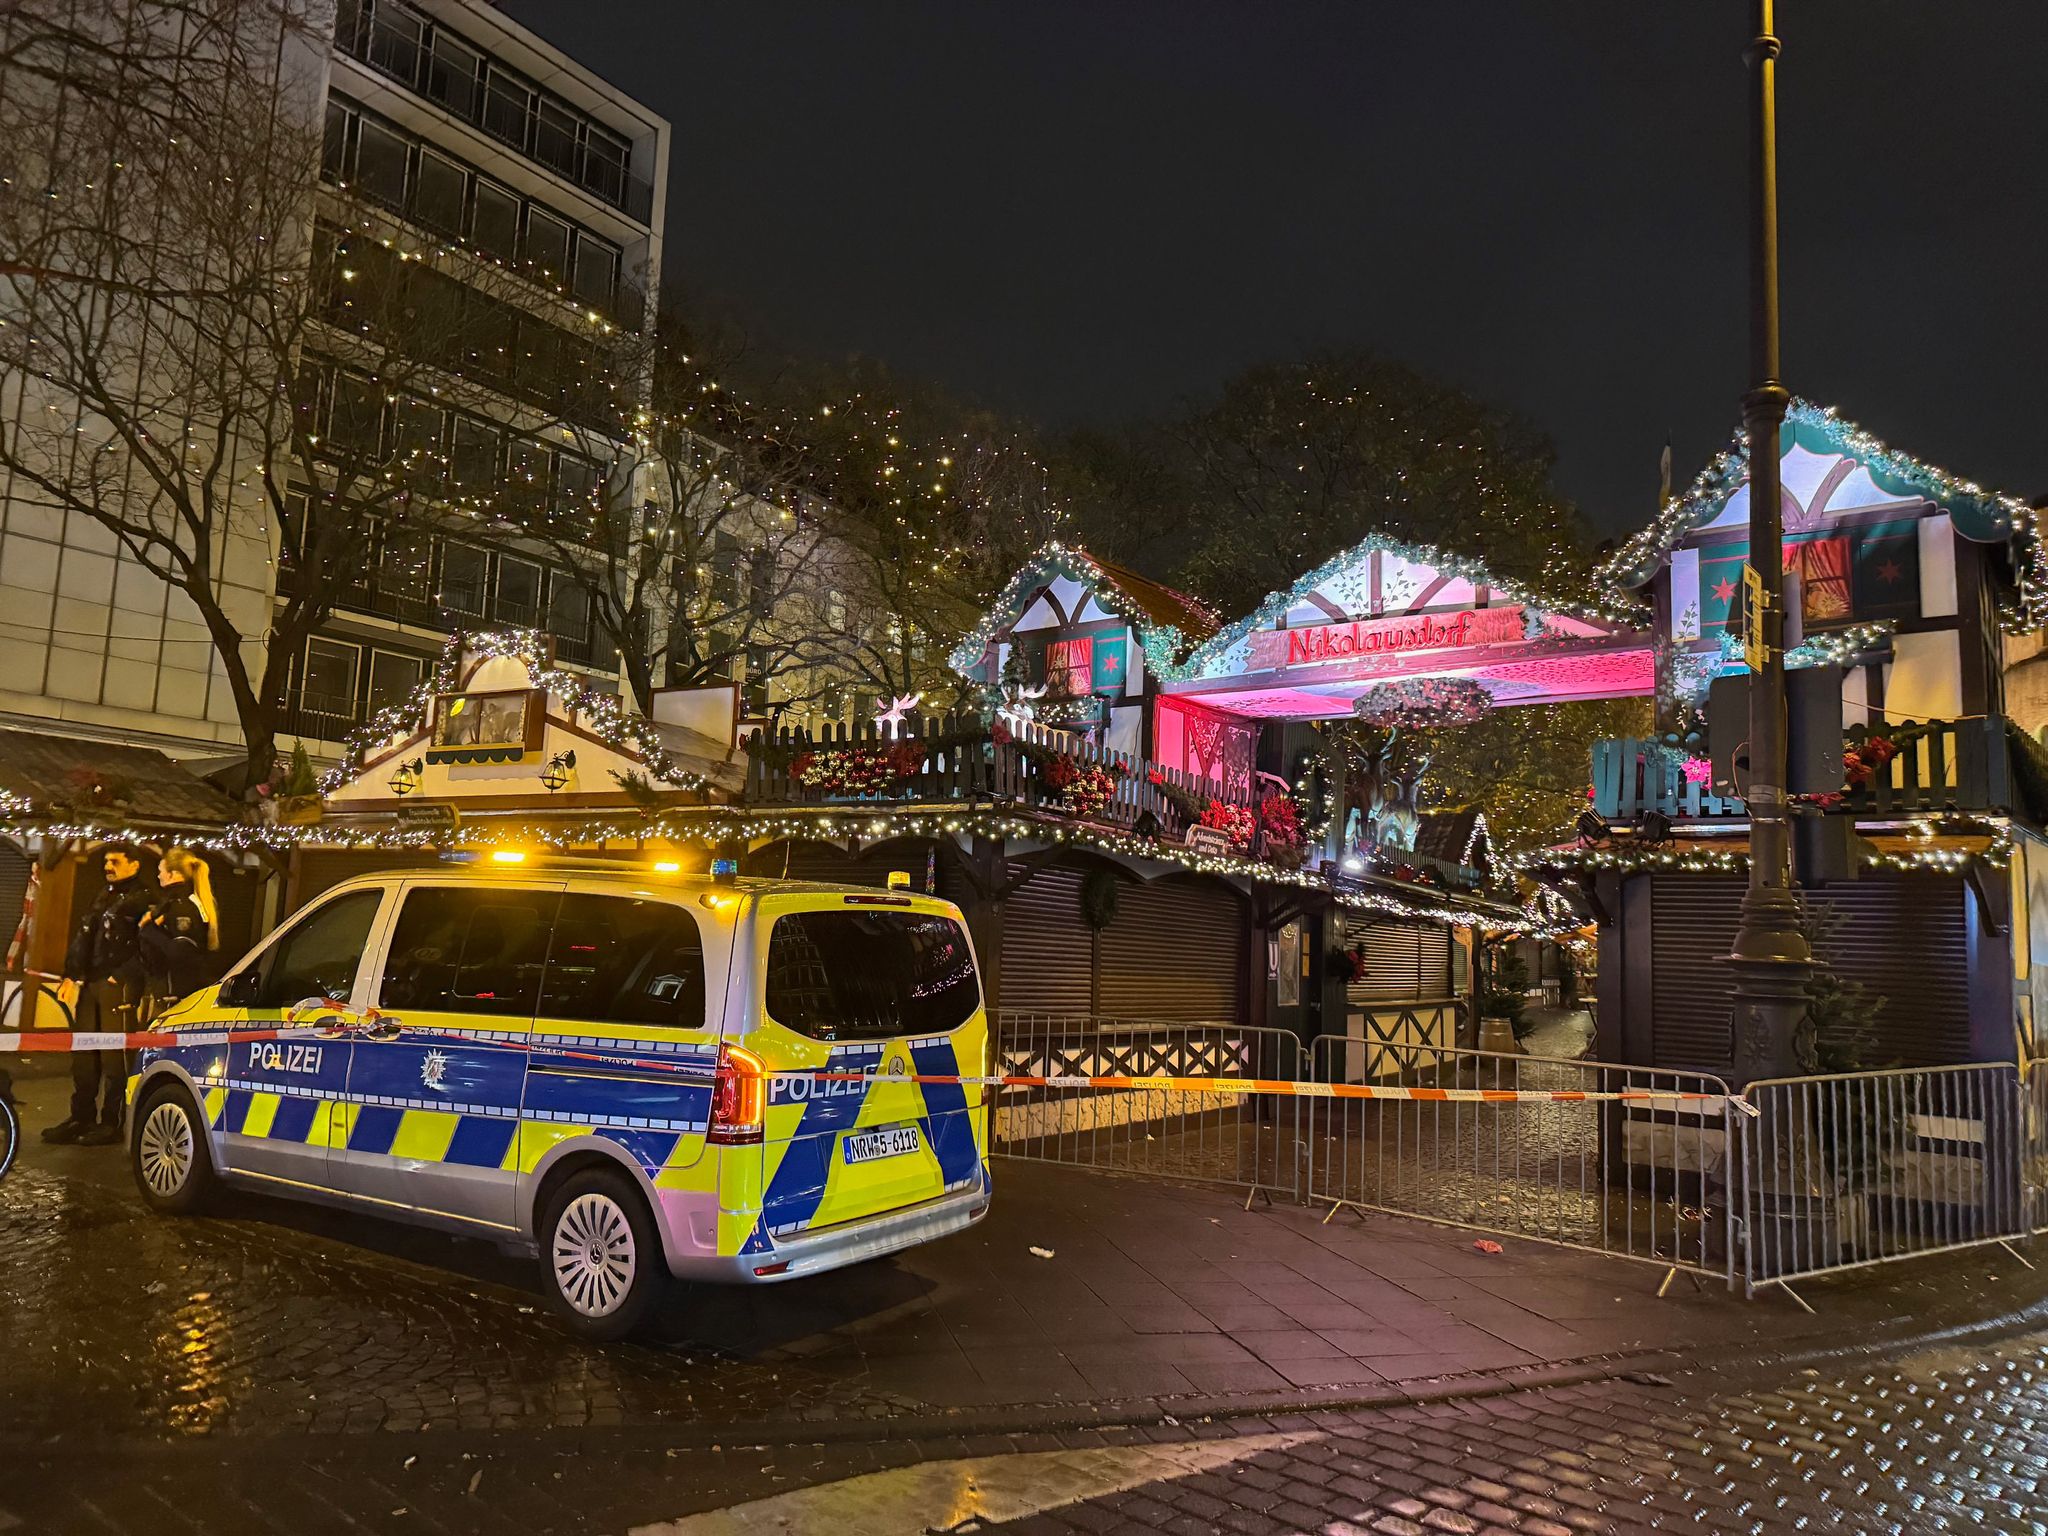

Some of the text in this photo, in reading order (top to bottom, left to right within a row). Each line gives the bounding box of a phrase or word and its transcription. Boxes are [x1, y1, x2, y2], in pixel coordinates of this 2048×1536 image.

[1288, 612, 1474, 664] Nikolausdorf
[249, 1042, 322, 1074] POLIZEI
[851, 1130, 919, 1160] NRW 5-6118
